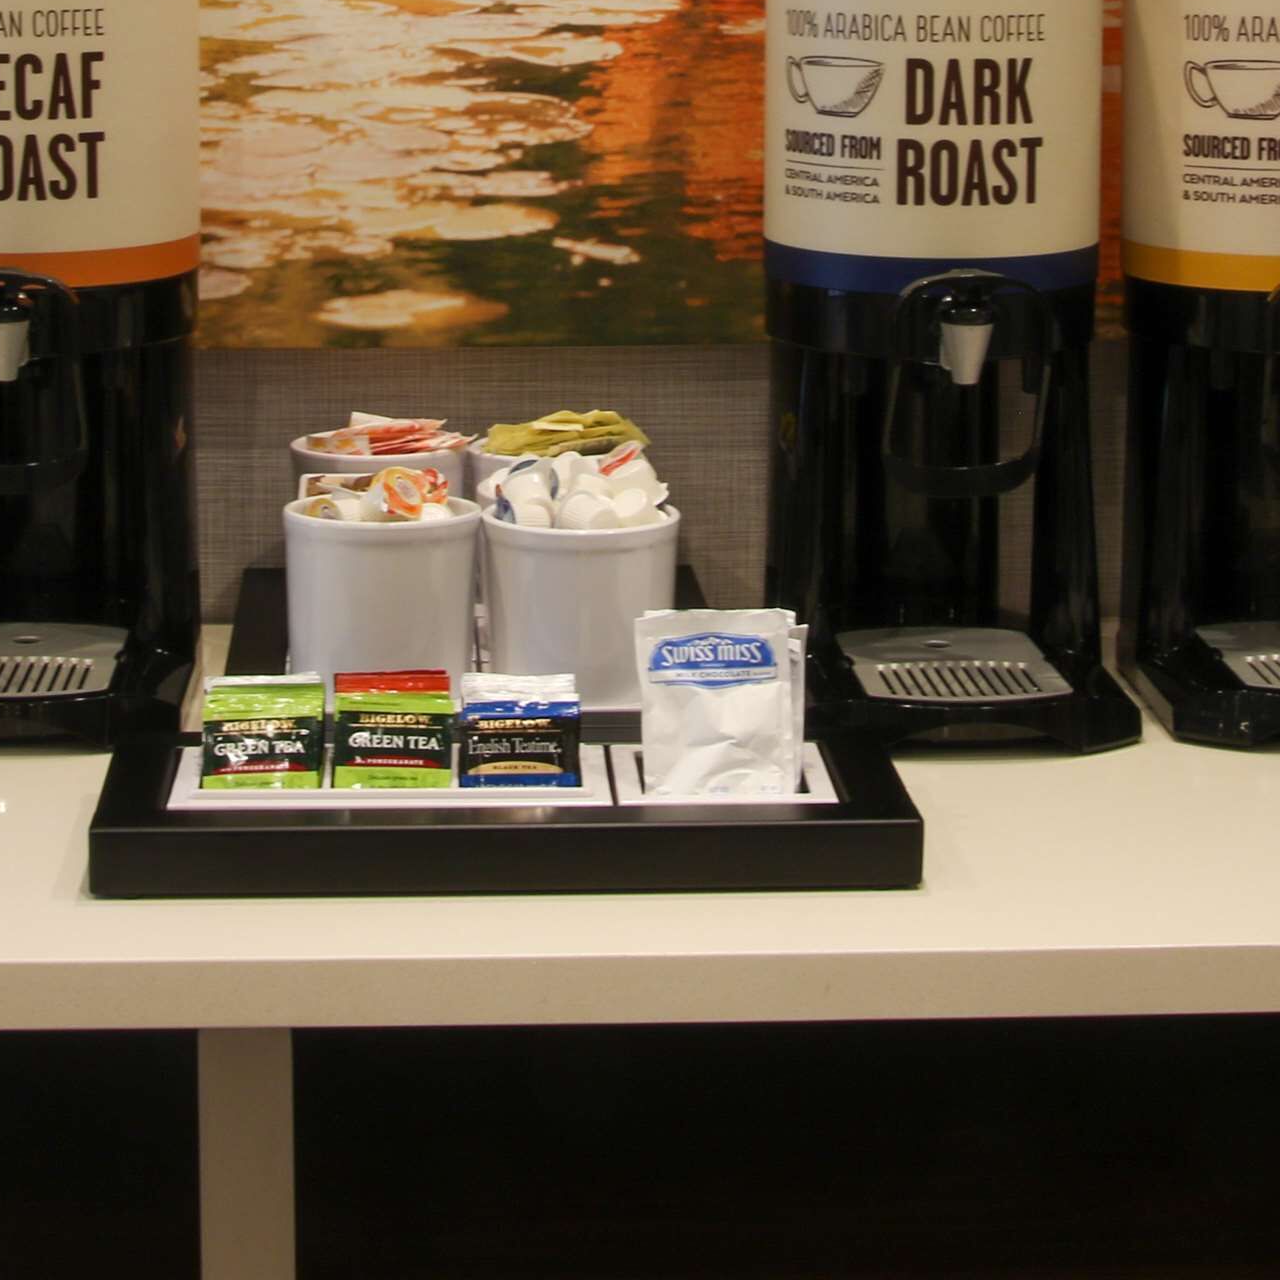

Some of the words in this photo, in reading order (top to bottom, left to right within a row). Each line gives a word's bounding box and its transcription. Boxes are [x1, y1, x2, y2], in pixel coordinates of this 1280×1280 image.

[32, 8, 106, 38] COFFEE
[785, 8, 819, 39] 100%
[823, 12, 907, 42] ARABICA
[916, 14, 971, 44] BEAN
[980, 13, 1046, 43] COFFEE
[1183, 12, 1230, 42] 100%
[905, 57, 1034, 126] DARK
[784, 128, 835, 157] SOURCED
[840, 133, 882, 162] FROM
[1182, 133, 1252, 161] SOURCED
[825, 173, 880, 188] AMERICA
[896, 136, 1044, 207] ROAST
[1182, 172, 1237, 187] CENTRAL
[824, 190, 881, 205] AMERICA
[1182, 189, 1191, 202] &
[1193, 190, 1237, 204] SOUTH
[359, 713, 433, 725] BIGELOW
[476, 718, 552, 730] BIGELOW
[213, 739, 270, 756] GREEN
[348, 731, 404, 749] GREEN
[406, 735, 440, 751] TEA
[468, 738, 512, 757] English
